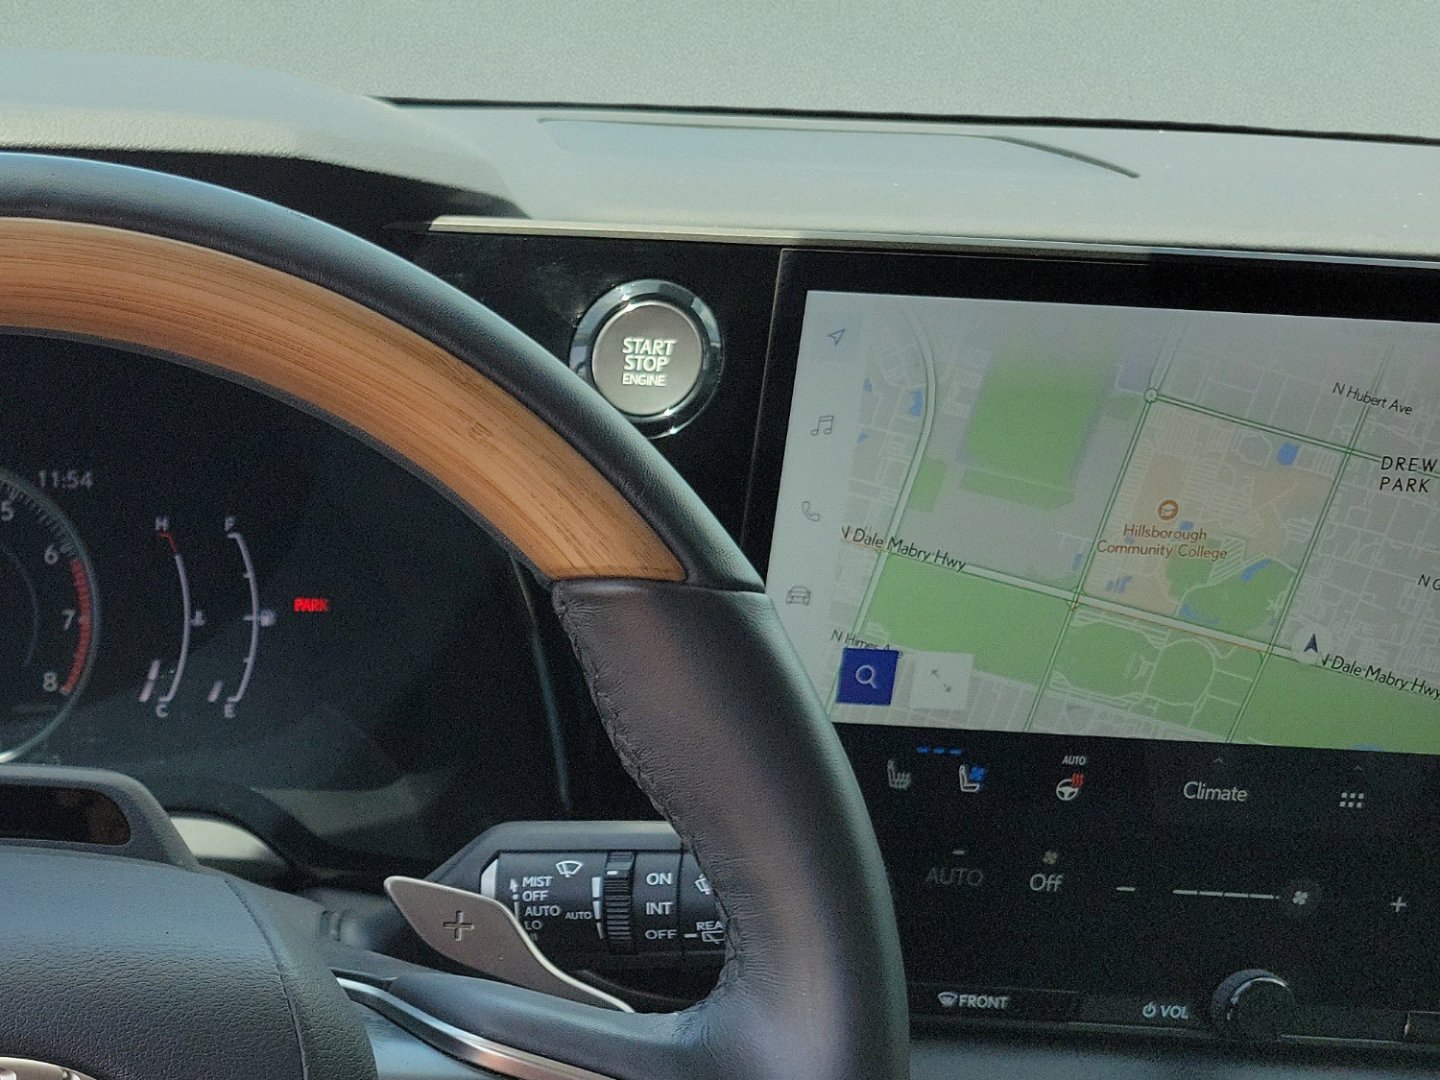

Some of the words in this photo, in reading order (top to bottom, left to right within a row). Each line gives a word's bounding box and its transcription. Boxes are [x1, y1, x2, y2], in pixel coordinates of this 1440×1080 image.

[622, 337, 677, 355] START
[624, 355, 670, 372] STOP
[622, 373, 667, 387] ENGINE
[1331, 382, 1346, 396] N
[1346, 386, 1388, 408] Hubert
[1388, 399, 1413, 415] Ave
[1380, 455, 1439, 473] DREW
[1379, 476, 1431, 493] PARK
[0, 503, 14, 522] 5
[1122, 523, 1208, 543] Hillsborough
[44, 547, 58, 565] 6
[852, 528, 884, 549] Dale
[886, 536, 932, 563] Mabry
[933, 549, 967, 573] Hwy
[1096, 539, 1173, 559] Community
[1178, 544, 1228, 562] College
[1417, 574, 1431, 587] N
[62, 610, 75, 630] 7
[43, 672, 58, 692] 8
[1331, 655, 1362, 676] Dale
[1365, 665, 1409, 691] Mabry
[1410, 677, 1440, 701] Hwy
[1061, 755, 1087, 766] AUTO
[1183, 781, 1248, 803] Climate
[522, 876, 553, 888] MIST
[646, 873, 672, 885] ON
[925, 866, 984, 887] AUTO
[1029, 872, 1063, 892] Off
[522, 890, 549, 902] OFF
[524, 905, 560, 917] AUTO
[565, 911, 593, 920] AUTO
[646, 901, 673, 915] INT
[524, 920, 543, 931] LO
[645, 929, 677, 940] OFF
[958, 993, 1008, 1009] FRONT
[1159, 1004, 1189, 1020] VOL
